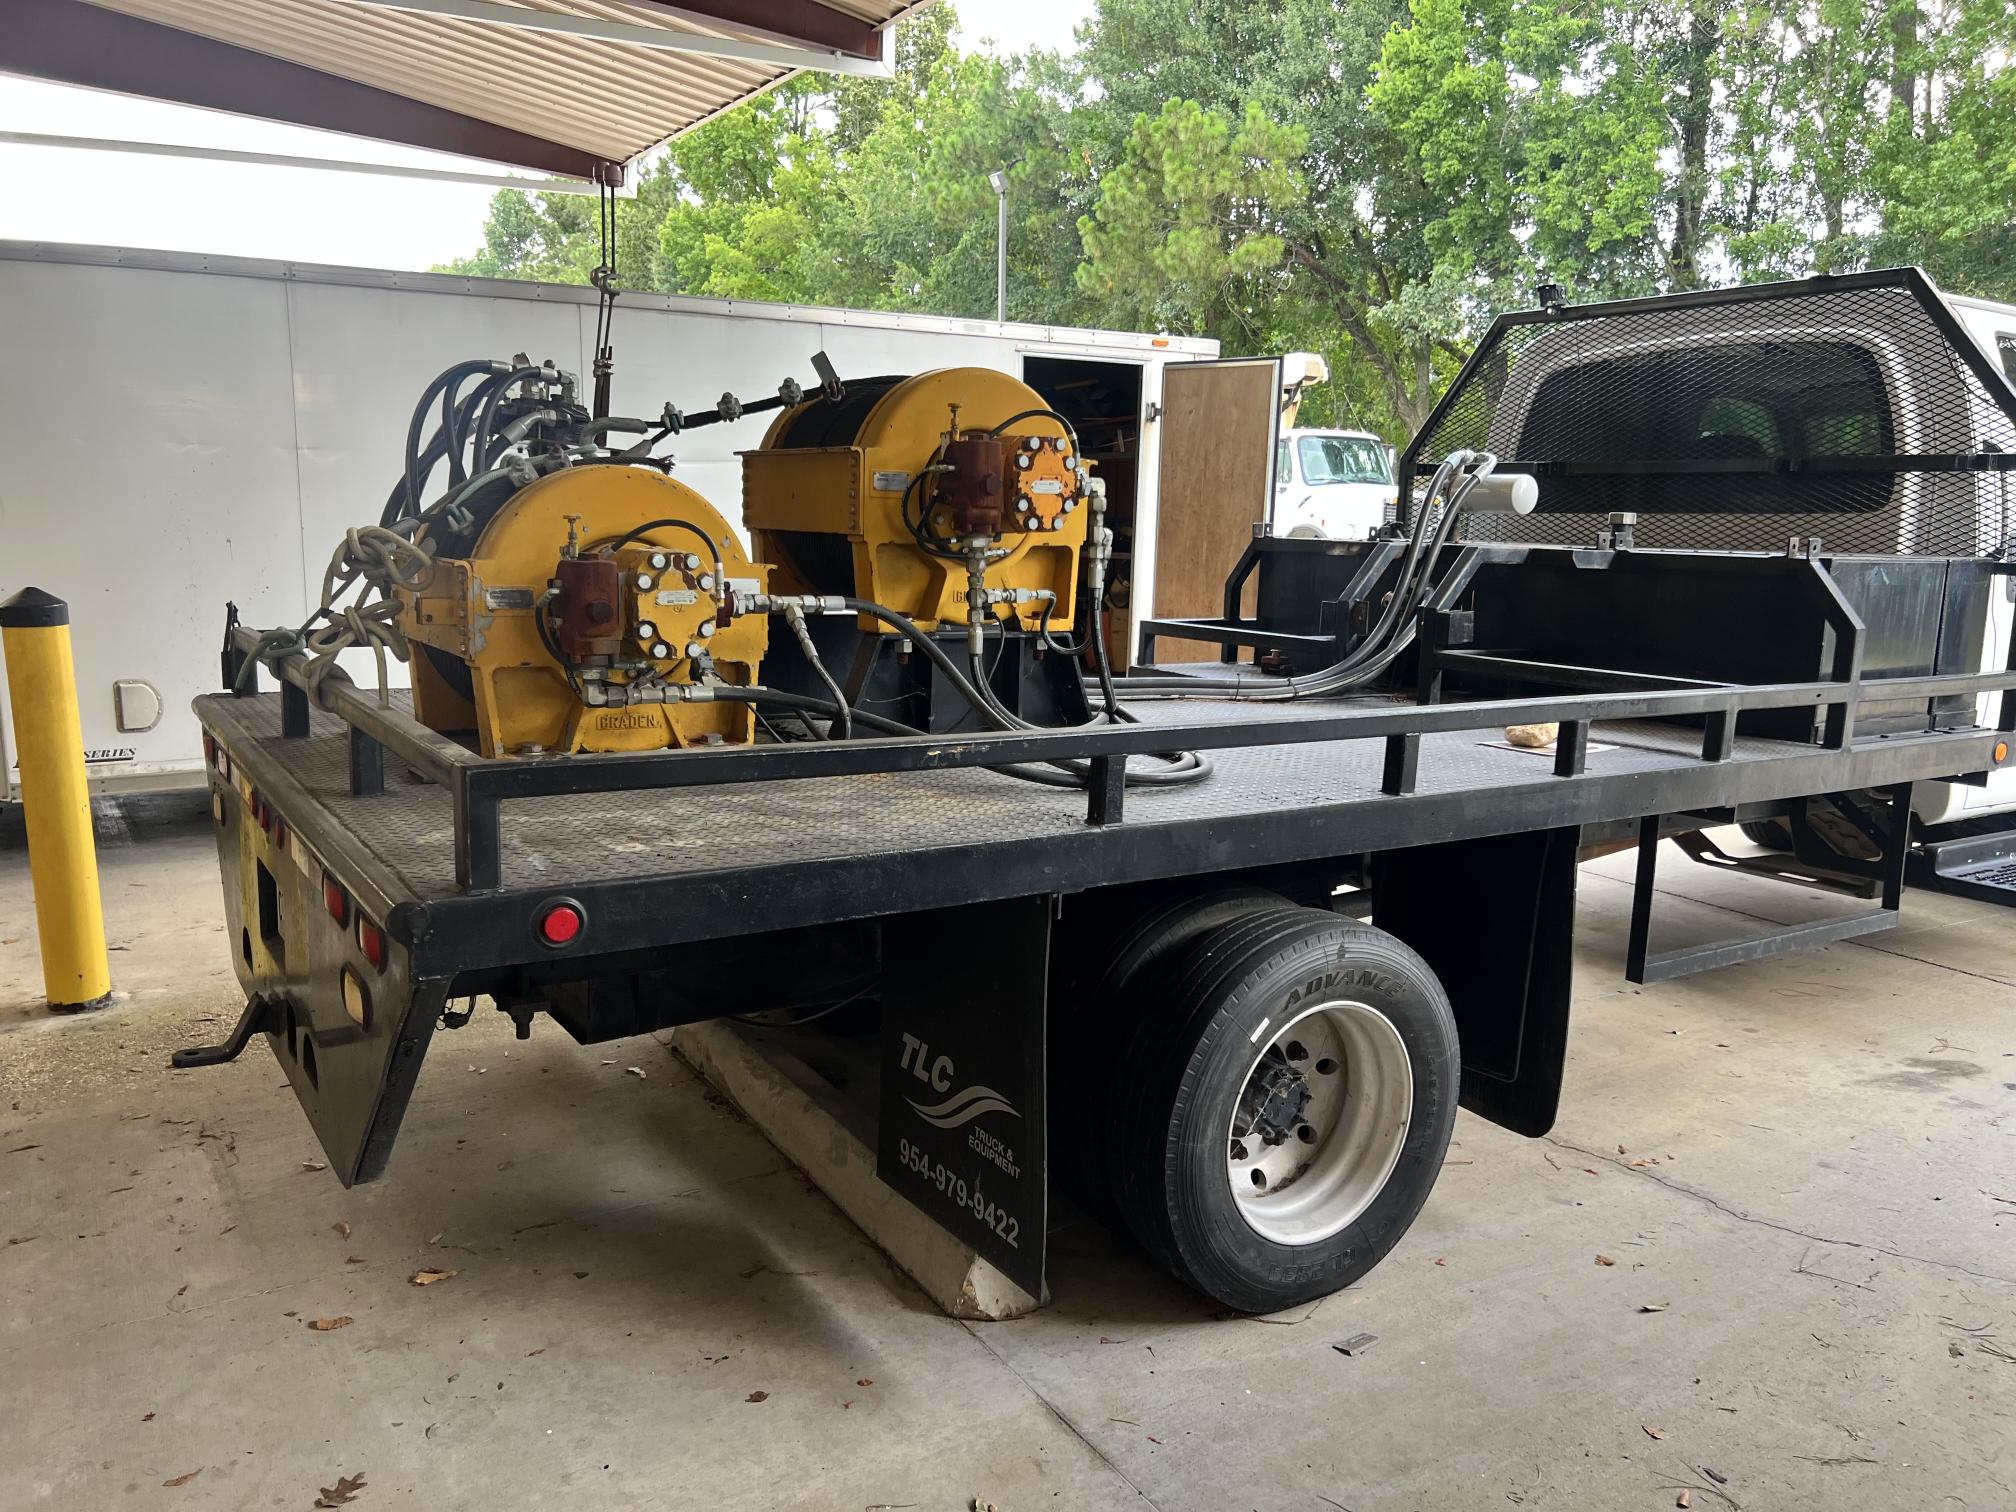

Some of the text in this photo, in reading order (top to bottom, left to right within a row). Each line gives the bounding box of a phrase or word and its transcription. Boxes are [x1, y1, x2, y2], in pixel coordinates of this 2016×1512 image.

[599, 714, 656, 729] BRADEN
[84, 747, 136, 759] SERIES
[1282, 968, 1405, 1013] ADVANCE
[900, 1031, 954, 1093] TLC
[968, 1134, 1021, 1179] EQUIPMENT
[974, 1125, 1014, 1162] TRUCK &
[899, 1138, 1019, 1249] 954-979-9422
